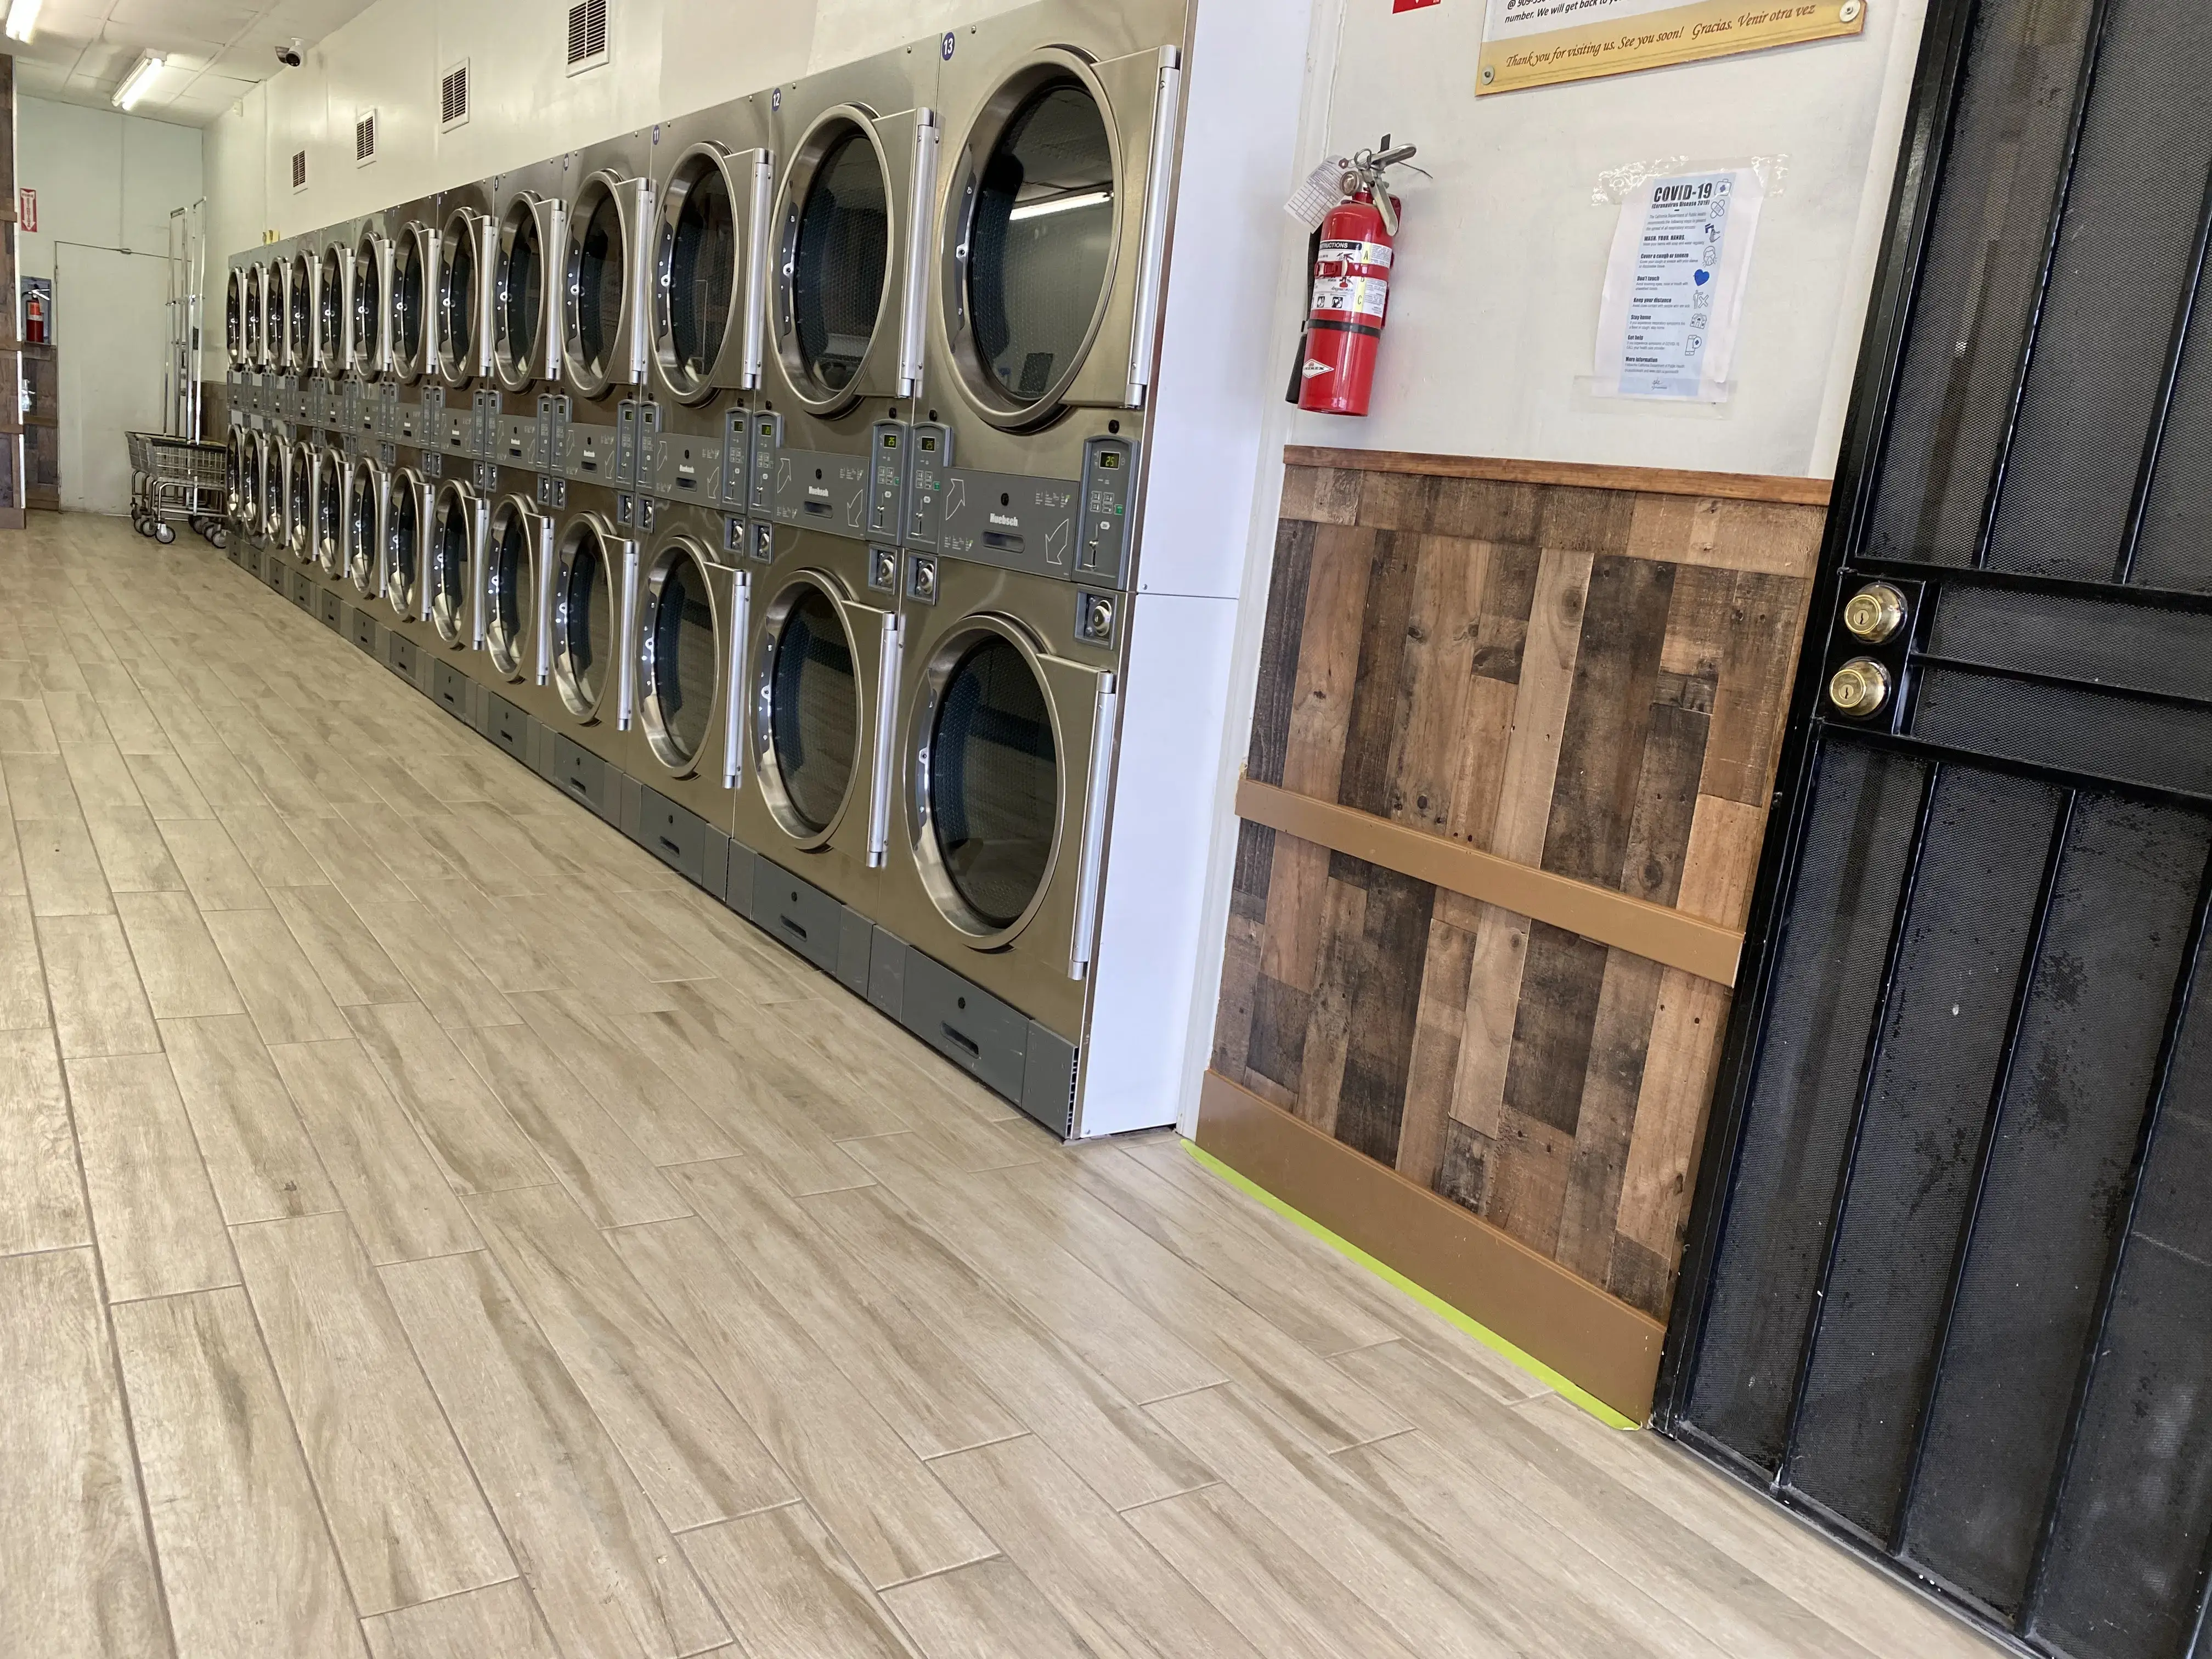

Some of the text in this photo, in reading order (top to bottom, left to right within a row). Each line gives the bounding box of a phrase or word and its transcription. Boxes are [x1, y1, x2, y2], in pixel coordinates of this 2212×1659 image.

[1505, 11, 1534, 23] number.
[1537, 8, 1549, 17] We
[1551, 3, 1565, 14] will
[1565, 1, 1578, 13] get
[1579, 0, 1596, 9] back
[1691, 4, 1816, 40] Gracias. Venir otra vez
[944, 38, 953, 55] 13
[1506, 26, 1684, 67] Thank you for visiting us. See you soon!
[774, 93, 780, 107] 12
[654, 129, 659, 141] 11
[1654, 183, 1712, 202] COVID-19
[1363, 251, 1368, 260] A
[1358, 295, 1362, 304] C
[1105, 456, 1115, 467] 25
[990, 513, 1018, 527] Huebsch
